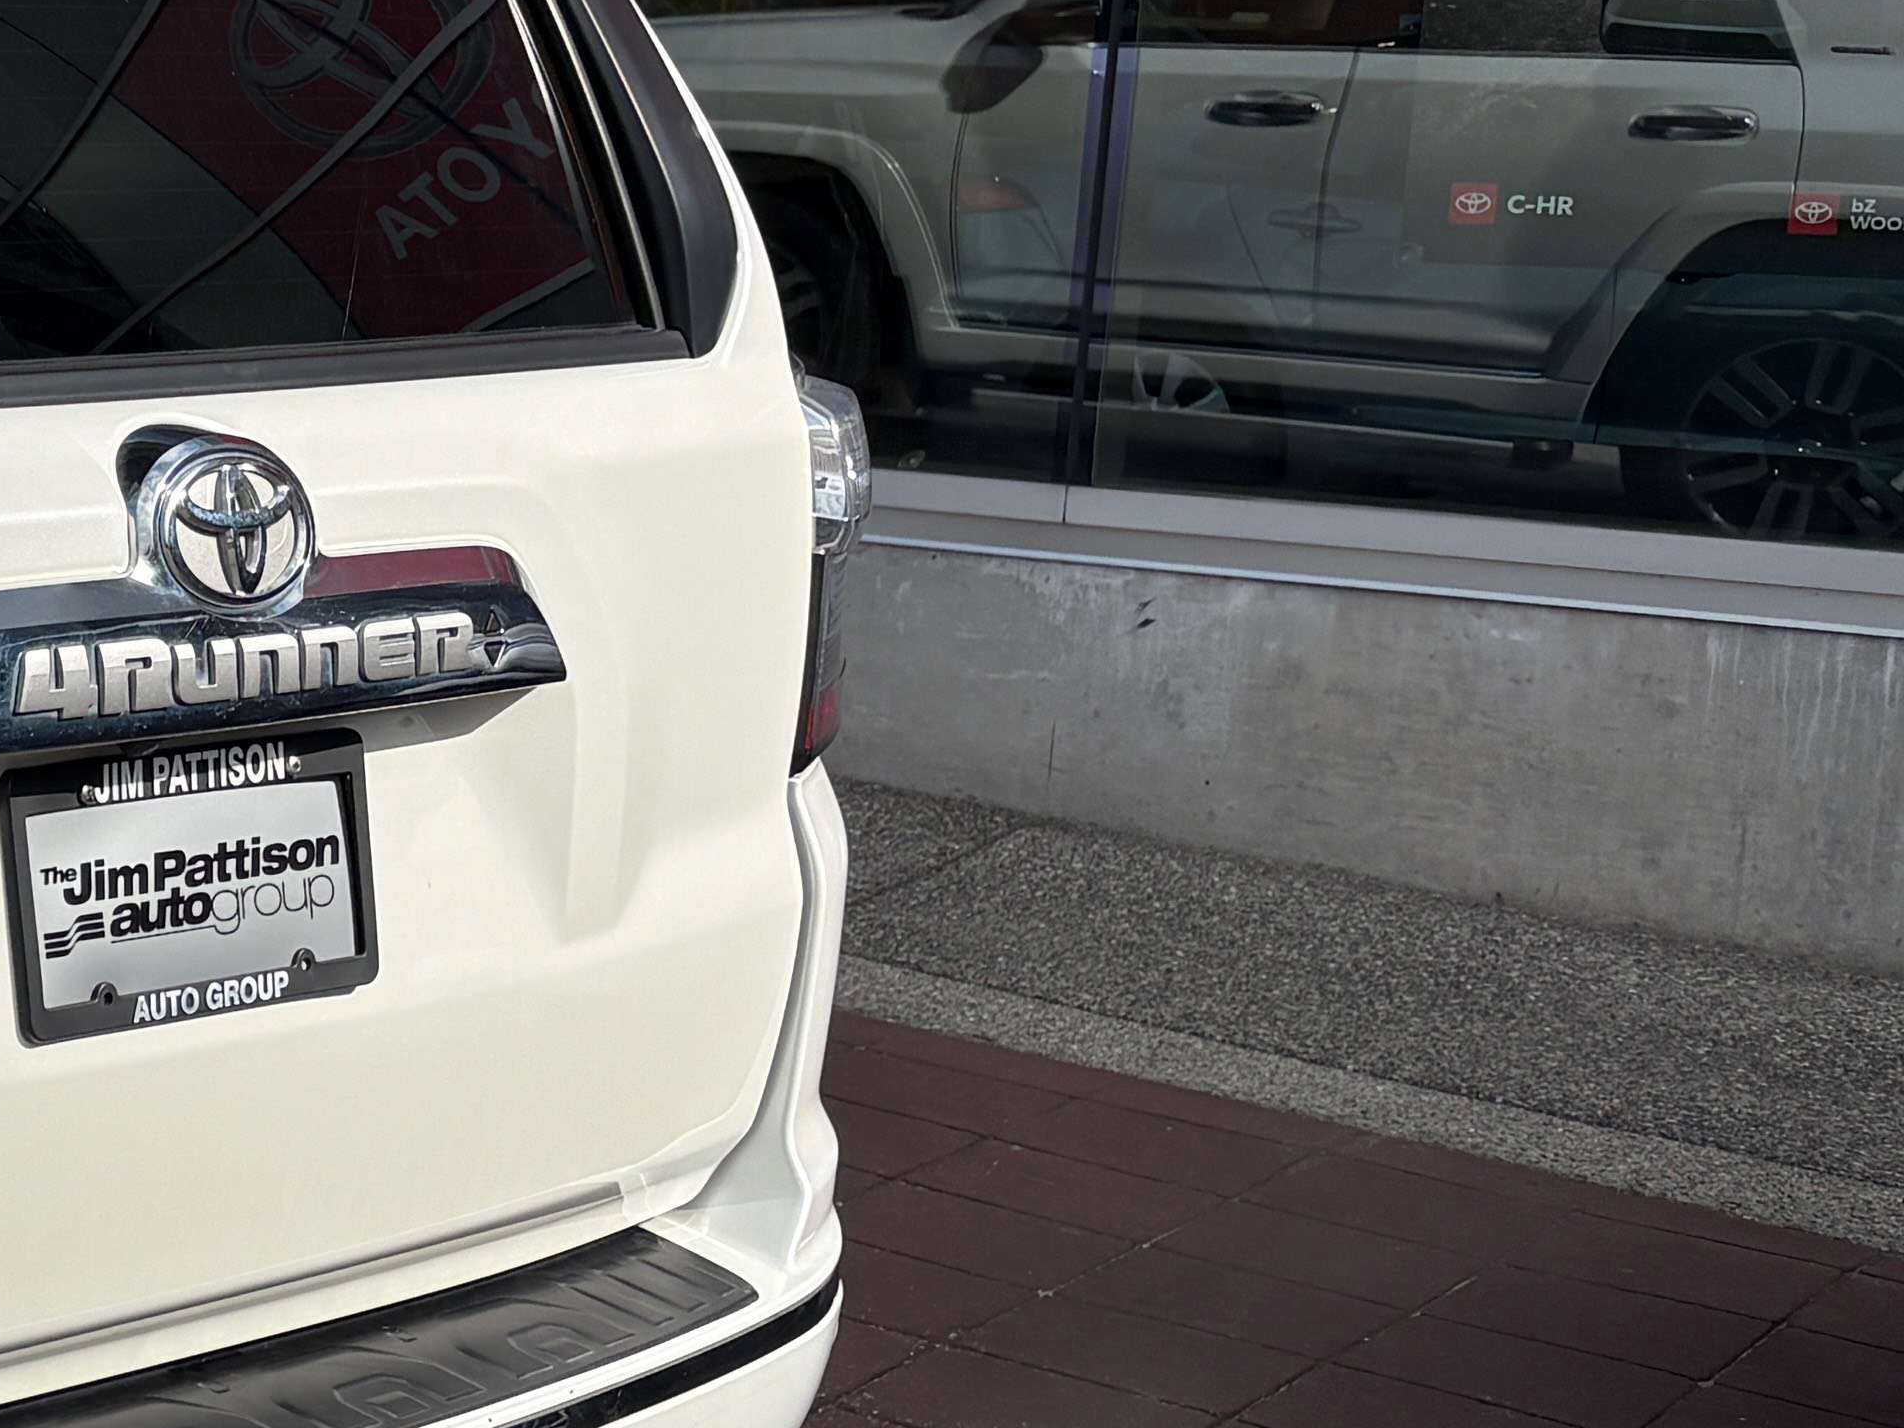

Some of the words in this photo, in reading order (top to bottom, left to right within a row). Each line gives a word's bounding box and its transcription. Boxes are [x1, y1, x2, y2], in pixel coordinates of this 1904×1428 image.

[1506, 194, 1575, 217] C-HR
[1850, 215, 1904, 232] WOO
[1851, 198, 1877, 213] bZ
[93, 760, 144, 805] JIM
[152, 740, 287, 797] PATTISON
[40, 865, 78, 886] The
[63, 858, 149, 906] Jim
[153, 833, 341, 893] Pattison
[133, 984, 201, 1024] AUTO
[205, 970, 290, 1010] GROUP
